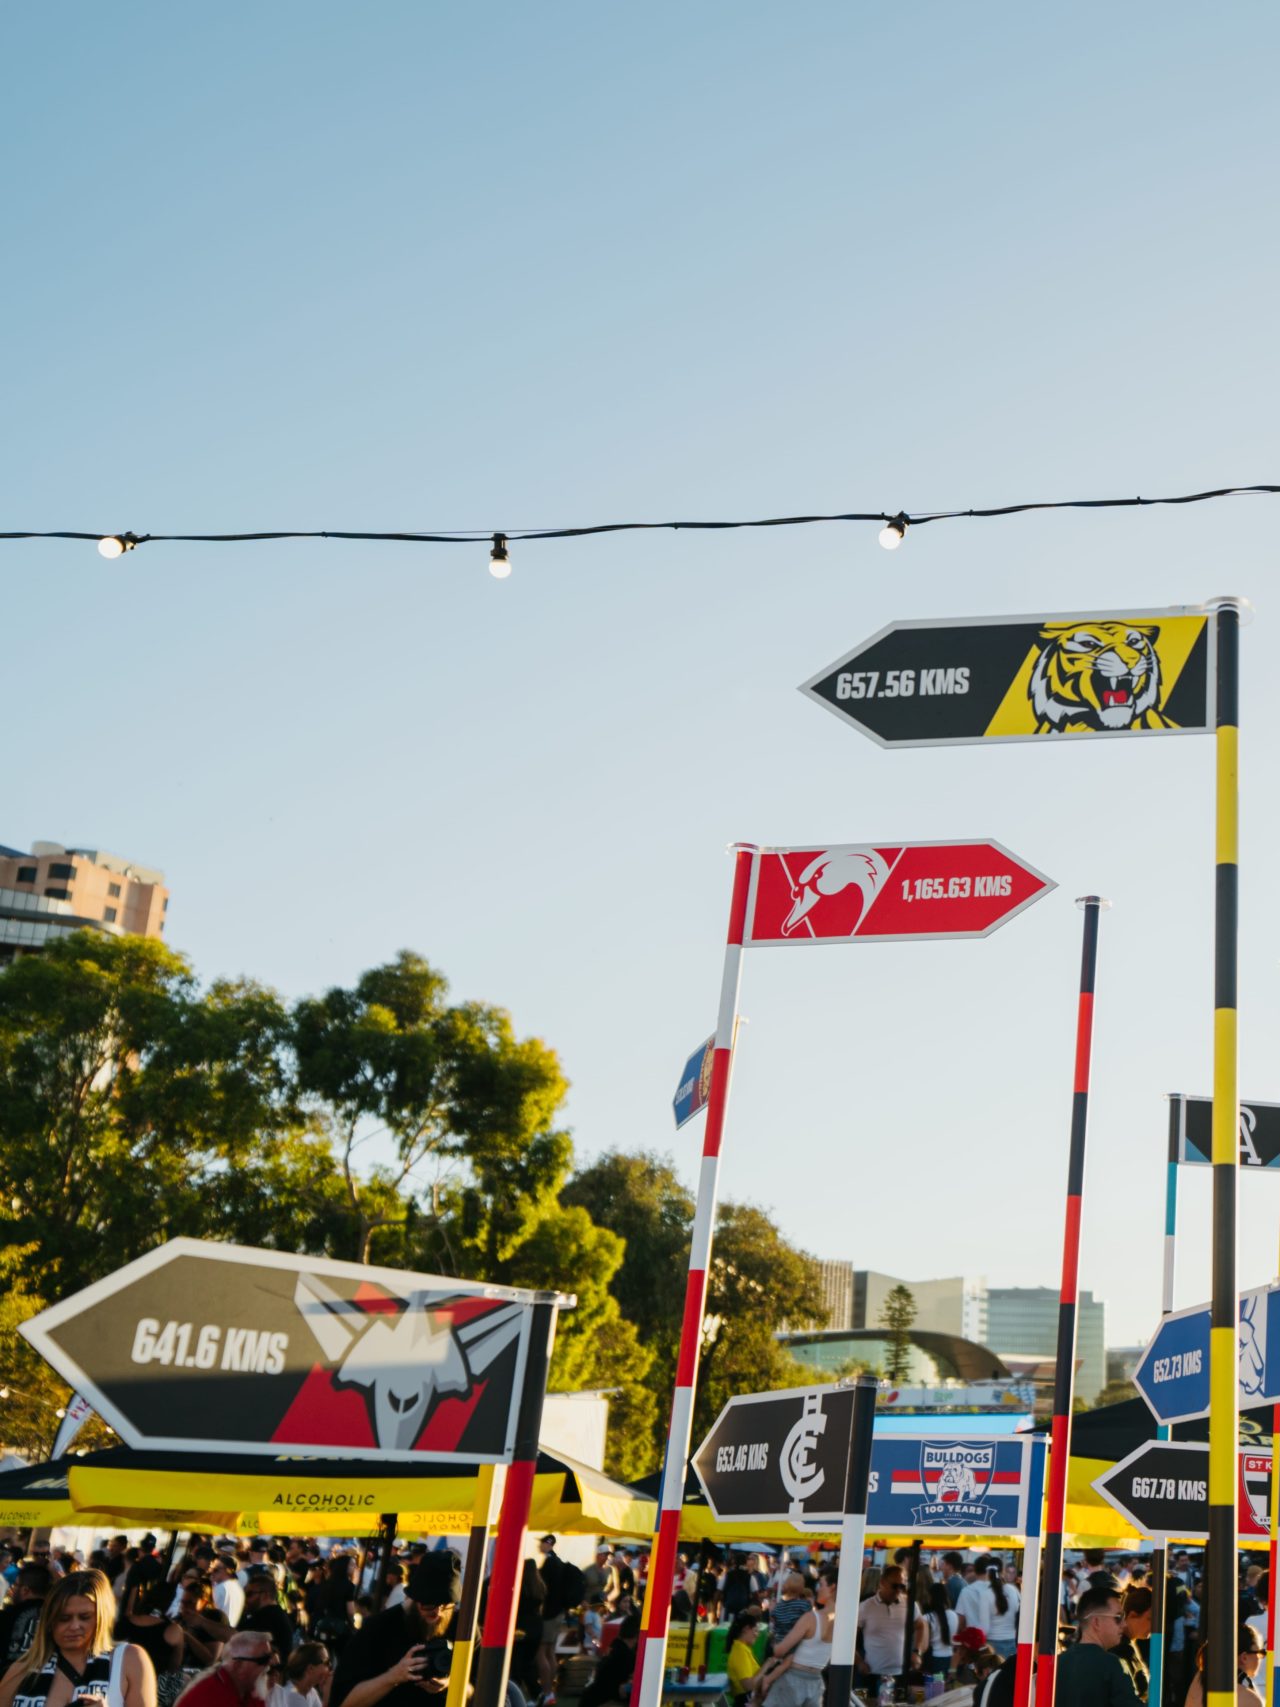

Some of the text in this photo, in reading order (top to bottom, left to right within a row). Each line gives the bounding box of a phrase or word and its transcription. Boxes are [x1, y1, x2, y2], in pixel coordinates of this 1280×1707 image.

[836, 667, 970, 700] 657.56 KMS
[901, 875, 1012, 903] 1,165.63 KMS
[131, 1317, 289, 1375] 641.6 KMS
[1153, 1349, 1202, 1384] 652.73 KMS
[716, 1442, 769, 1473] 653.46 KMS
[926, 1451, 990, 1464] BULLDOGS
[273, 1493, 375, 1506] ALCOHOLIC
[1132, 1477, 1207, 1501] 667.78 KMS
[925, 1504, 983, 1515] 100 YEARS
